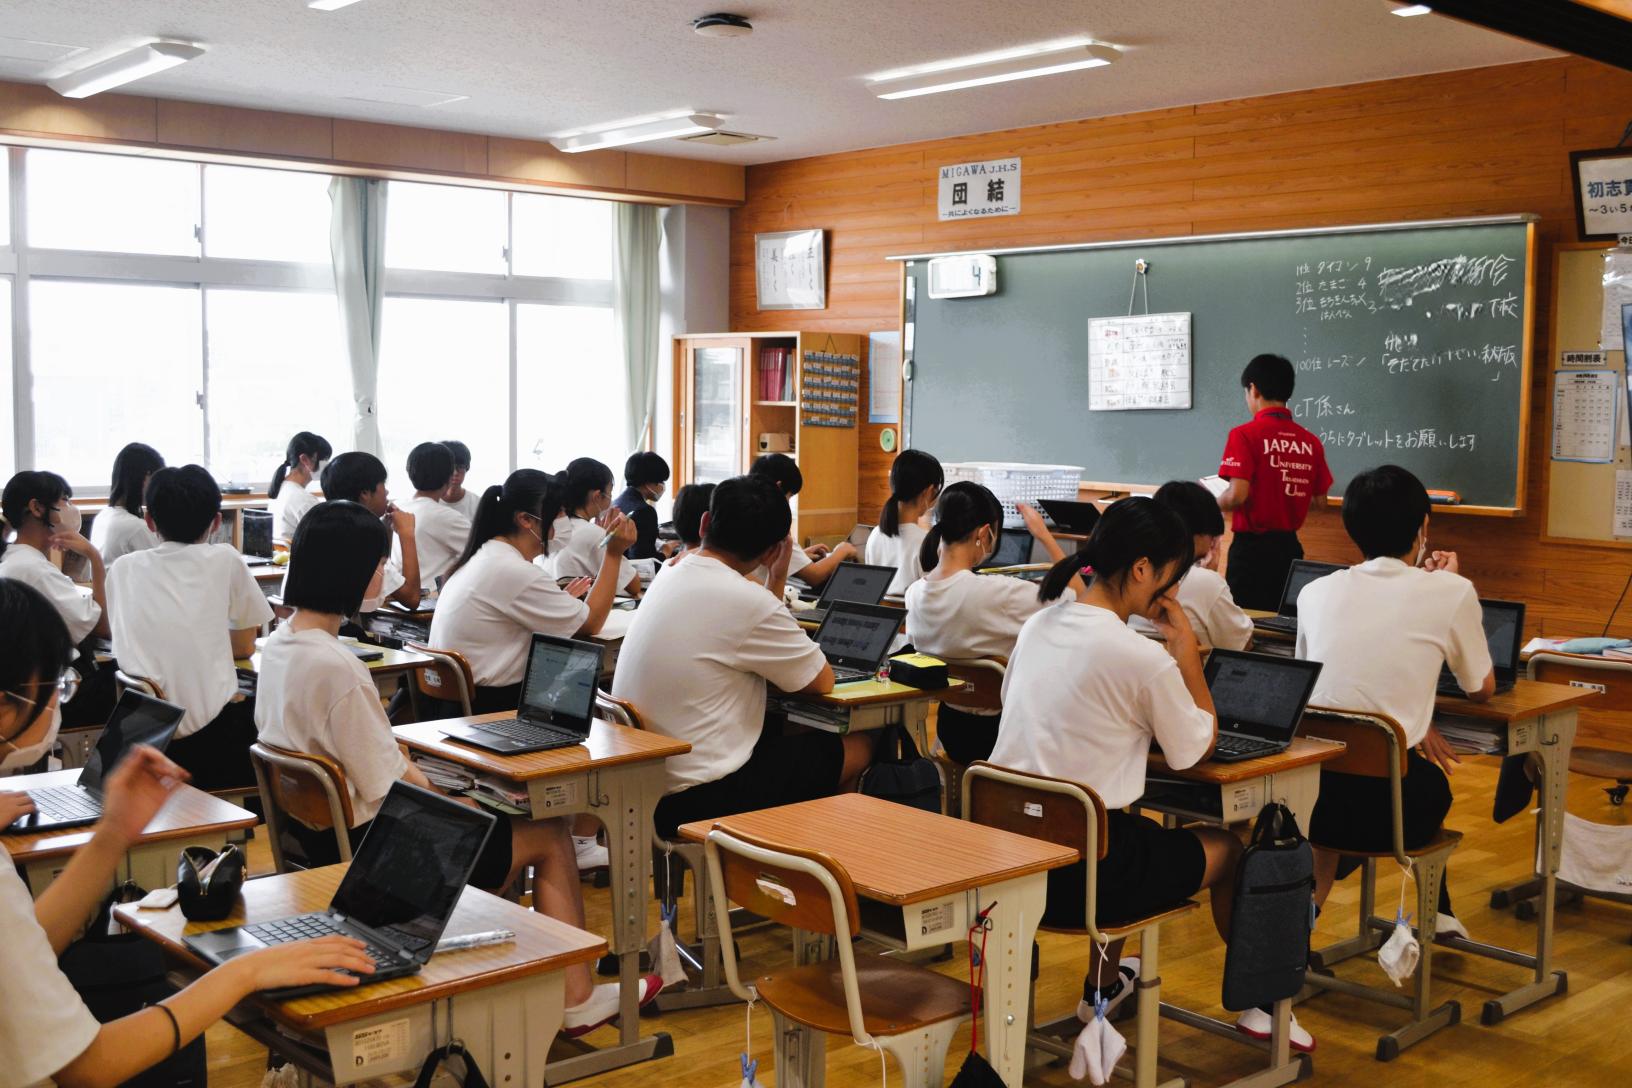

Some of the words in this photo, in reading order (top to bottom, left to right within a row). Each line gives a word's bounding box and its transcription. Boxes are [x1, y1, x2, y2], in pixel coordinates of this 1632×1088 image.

[942, 164, 986, 179] MIGAWA
[1357, 276, 1368, 290] 4
[1263, 438, 1313, 456] JAPAN
[1308, 427, 1476, 452] うちにタブレットをお願いします
[1269, 455, 1313, 471] UNIVERSITY
[355, 1055, 364, 1066] D
